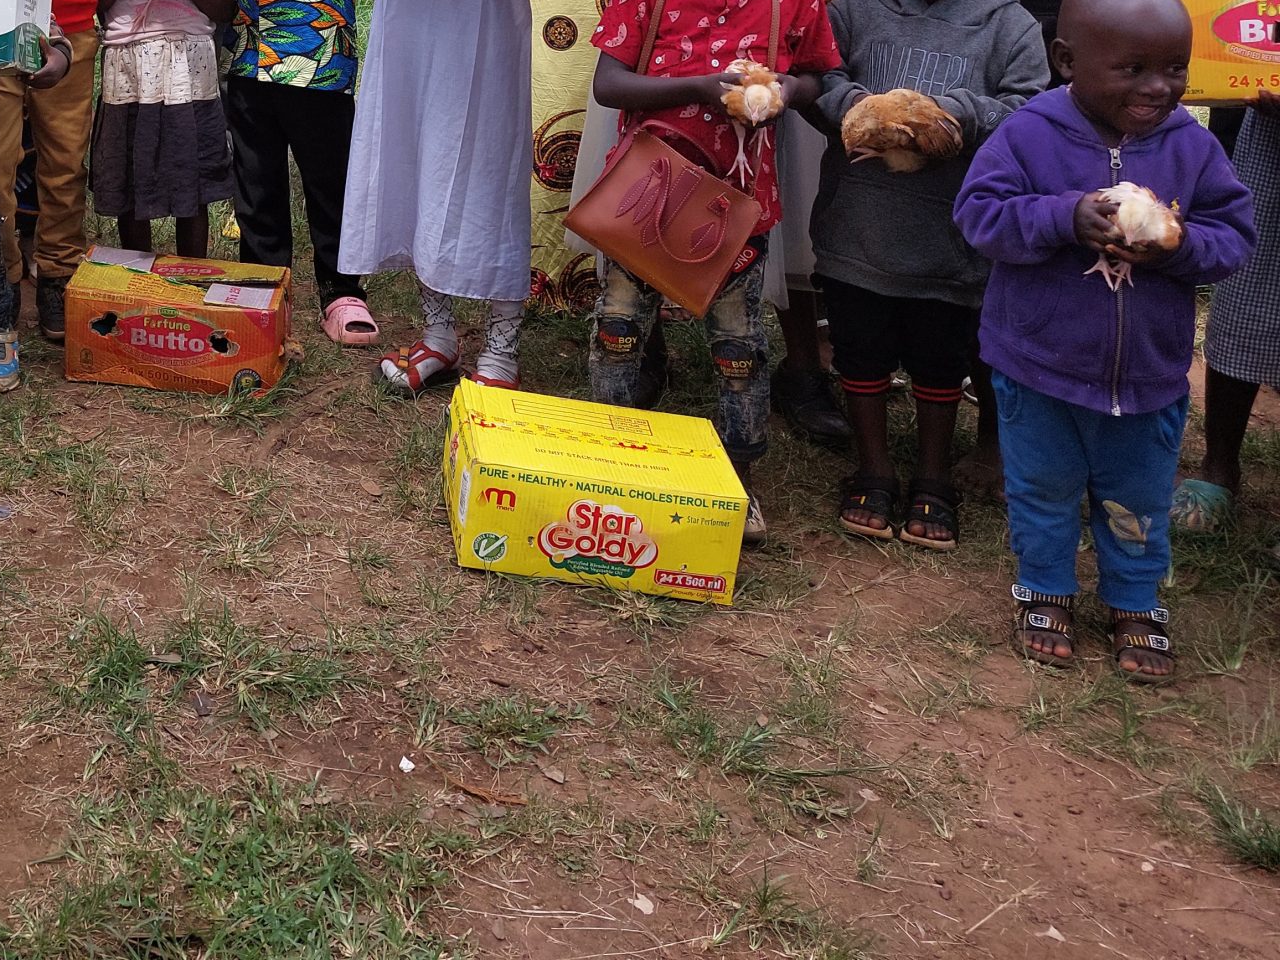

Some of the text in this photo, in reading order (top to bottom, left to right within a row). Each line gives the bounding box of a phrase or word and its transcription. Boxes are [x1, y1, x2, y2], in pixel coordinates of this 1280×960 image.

[1230, 45, 1260, 60] FORTIFIED
[1229, 75, 1264, 88] 24 x
[143, 317, 191, 332] Fortune
[130, 328, 206, 352] Butto
[147, 369, 169, 381] 500
[173, 374, 187, 383] ml
[479, 466, 740, 512] PURE HEALTHY NATURAL CHOLESTEROL FREE
[575, 502, 636, 538] Star
[687, 515, 730, 528] Star Performer
[546, 525, 651, 566] Goldy
[660, 573, 673, 584] 24
[685, 576, 705, 588] 500
[707, 579, 721, 590] ml
